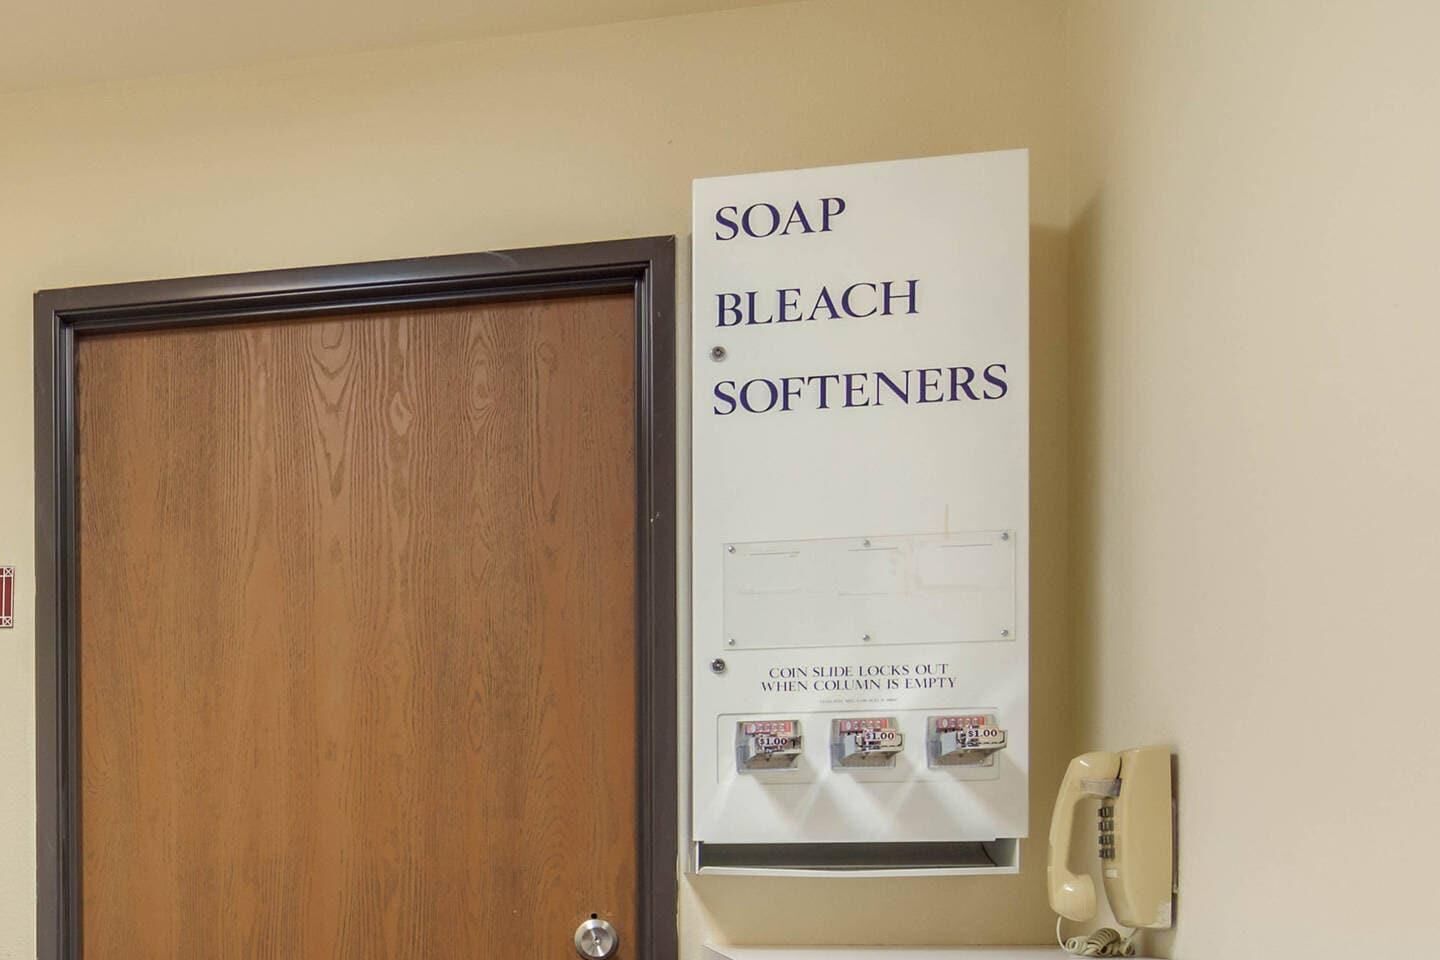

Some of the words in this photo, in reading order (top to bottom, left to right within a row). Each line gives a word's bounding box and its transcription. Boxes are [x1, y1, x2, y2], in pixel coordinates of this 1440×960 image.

[715, 197, 846, 241] SOAP
[715, 279, 920, 327] BLEACH
[713, 364, 1008, 415] SOFTENERS
[769, 667, 807, 679] COIN
[813, 665, 853, 678] SLIDE
[859, 664, 910, 677] LOCKS
[915, 663, 949, 675] OUT
[761, 680, 808, 692] WHEN
[814, 679, 881, 691] COLUMN
[887, 678, 899, 689] IS
[905, 677, 956, 689] EMPTY
[866, 732, 894, 741] $1.00
[968, 729, 998, 737] $1.00
[759, 737, 788, 746] $1.00
